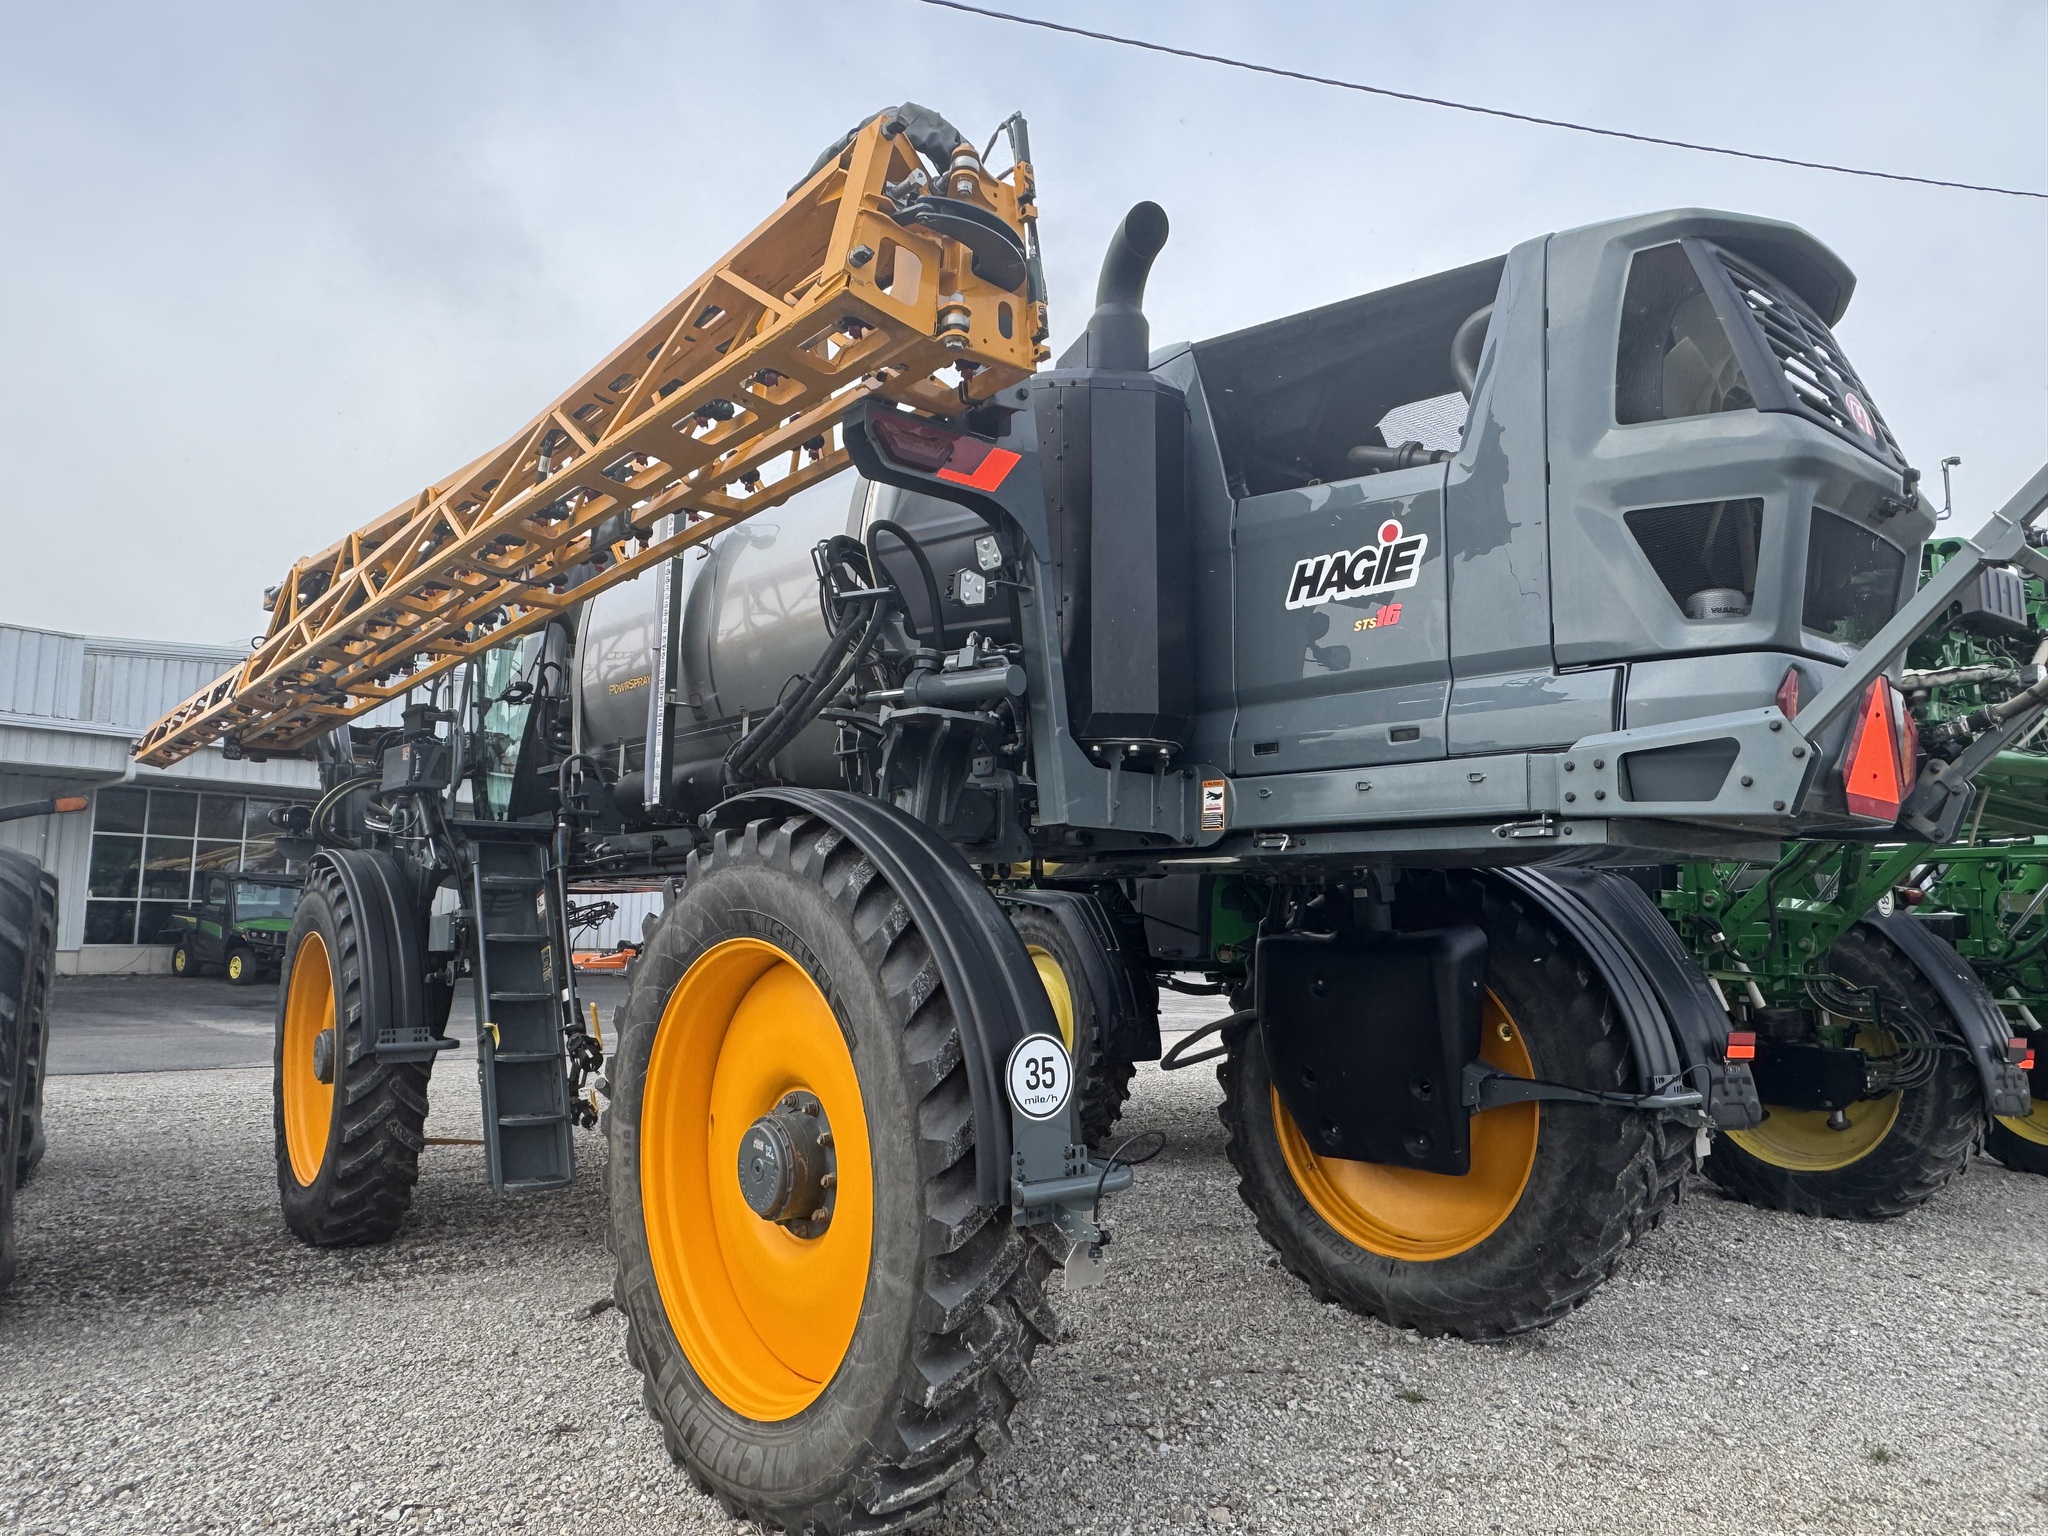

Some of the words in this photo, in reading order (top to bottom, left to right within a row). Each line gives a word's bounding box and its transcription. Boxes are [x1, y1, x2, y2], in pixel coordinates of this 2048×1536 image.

[1288, 522, 1424, 604] HAGIE
[749, 911, 834, 989] MICHELIN
[1025, 1056, 1055, 1090] 35
[1025, 1093, 1058, 1105] mile/h
[664, 1382, 803, 1490] MICHELIN
